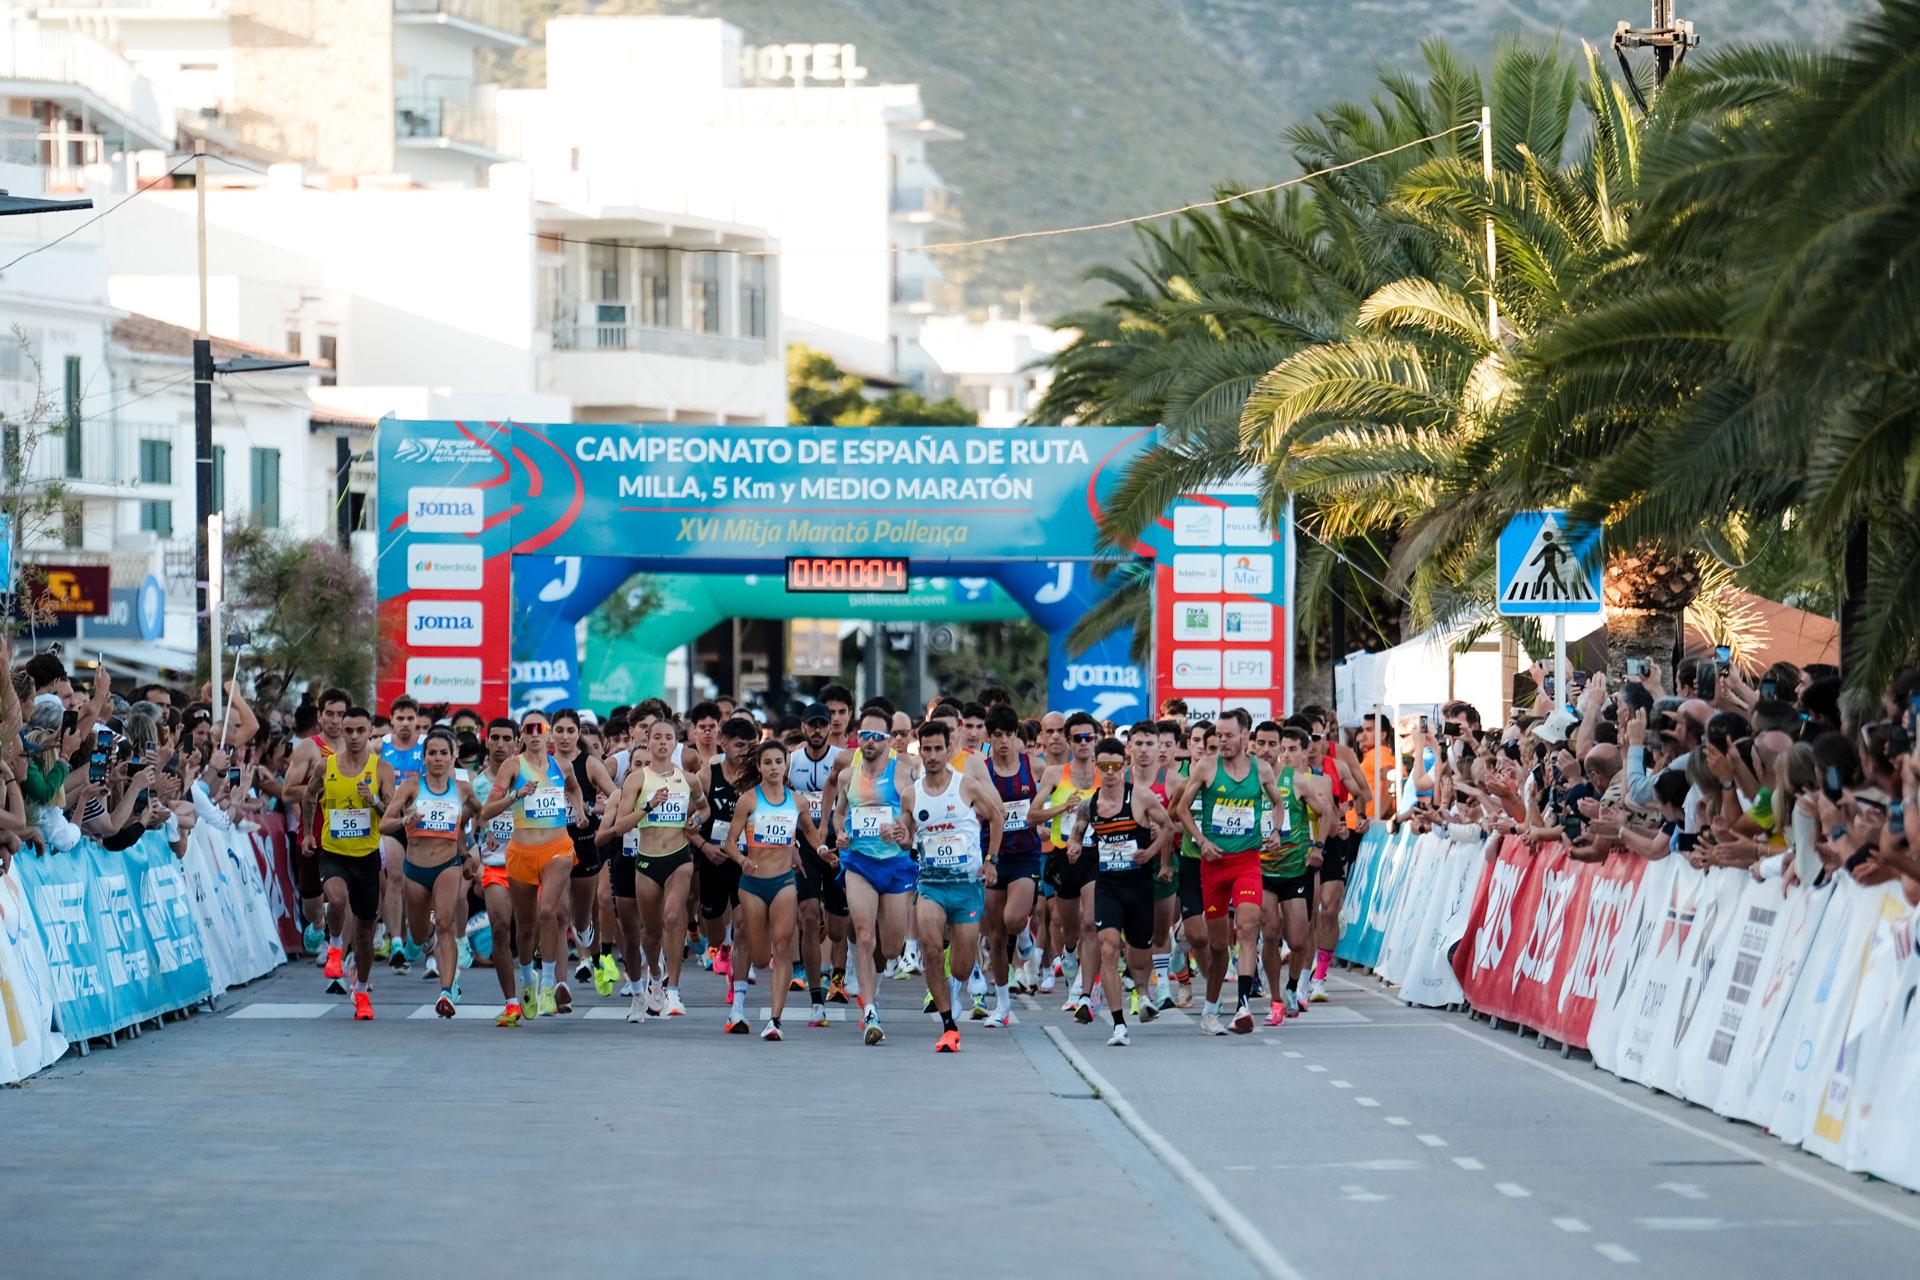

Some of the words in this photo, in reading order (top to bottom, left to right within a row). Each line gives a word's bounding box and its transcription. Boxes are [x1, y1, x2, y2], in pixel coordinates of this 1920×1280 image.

[735, 43, 868, 80] HOTEL
[575, 436, 792, 465] CAMPEONATO
[798, 439, 837, 465] DE
[843, 435, 960, 465] ESPAÑA
[965, 439, 1004, 465] DE
[1011, 439, 1089, 465] RUTA
[618, 475, 707, 502] MILLA,
[712, 477, 727, 499] 5
[733, 477, 775, 499] Km
[781, 482, 796, 503] y
[800, 477, 891, 500] MEDIO
[896, 473, 1033, 500] MARATÓN
[415, 501, 475, 518] Joma
[676, 518, 720, 541] XVI
[723, 518, 782, 548] Mitja
[786, 519, 869, 543] Marató
[873, 519, 969, 547] Pollença
[793, 559, 903, 588] 00:00:04
[414, 615, 474, 631] Joma
[510, 658, 570, 683] oma
[1230, 660, 1263, 676] LF91
[1063, 664, 1142, 692] Joma
[1187, 708, 1215, 720] abot
[536, 797, 557, 808] 104
[659, 802, 681, 813] 106
[430, 811, 445, 821] 85
[533, 808, 560, 818] Joma
[656, 813, 682, 823] Joma
[342, 819, 357, 829] 56
[423, 821, 450, 831] Joma
[492, 820, 513, 831] 625
[863, 817, 877, 828] 57
[1003, 820, 1026, 830] oma
[1226, 817, 1241, 827] 64
[337, 829, 364, 839] Joma
[765, 825, 787, 836] 105
[937, 845, 953, 857] 60
[932, 857, 960, 868] Joma
